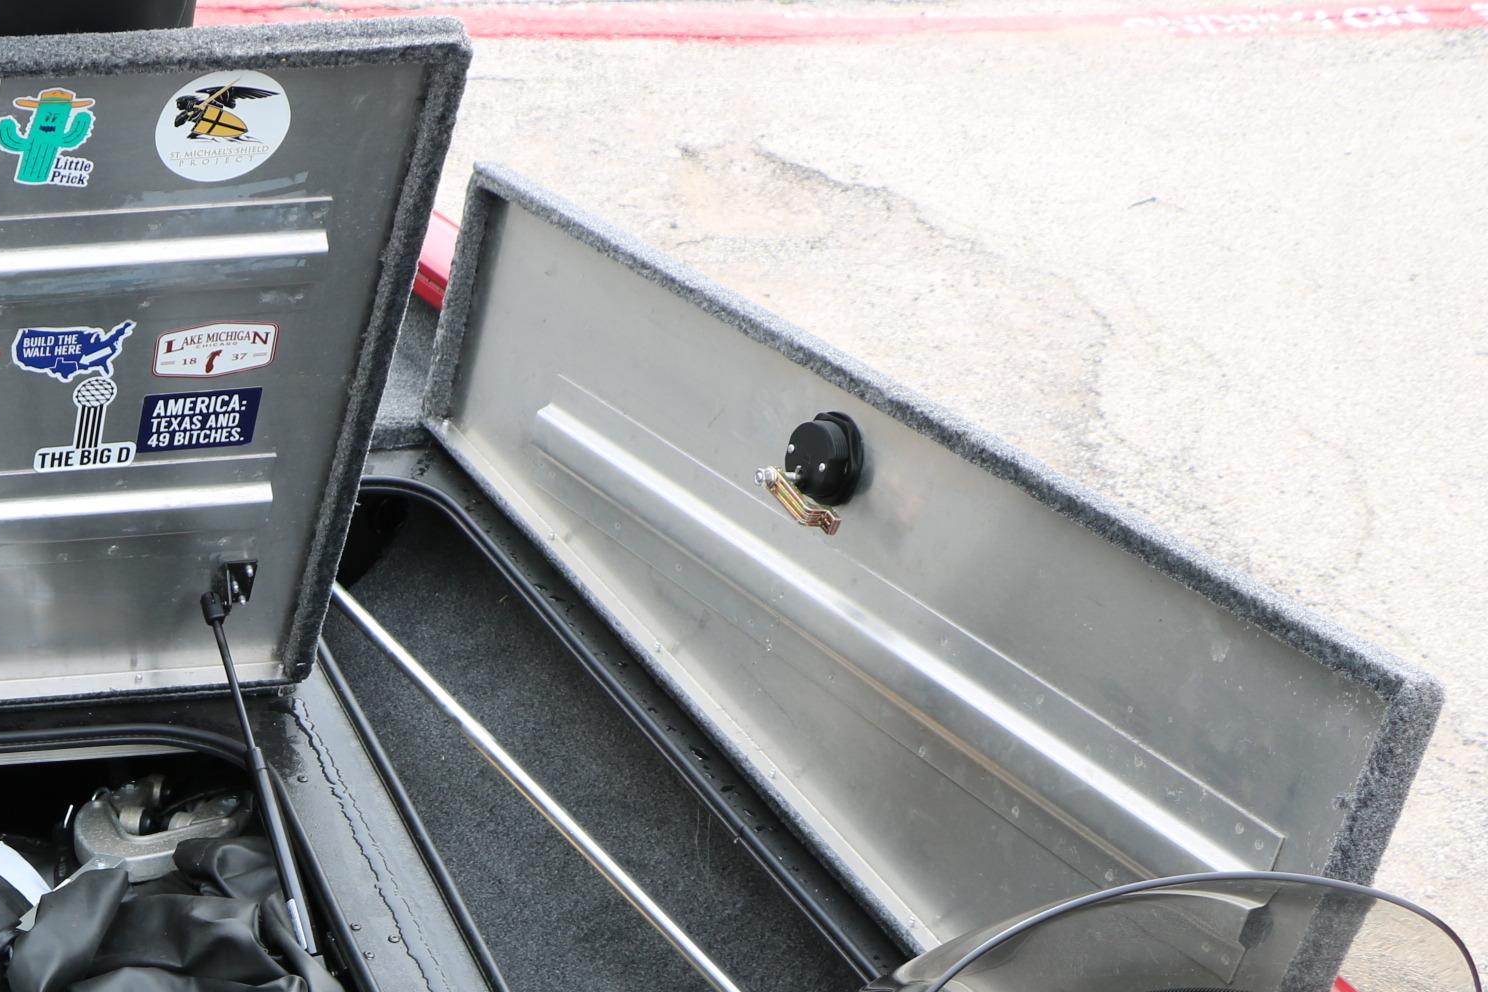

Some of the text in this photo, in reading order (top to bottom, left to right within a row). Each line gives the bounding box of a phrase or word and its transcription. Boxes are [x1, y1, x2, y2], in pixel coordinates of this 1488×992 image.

[184, 147, 233, 159] MICHAEL'S
[235, 145, 270, 154] SHIELD
[54, 157, 92, 172] Little
[178, 155, 254, 168] PROJECT
[50, 170, 87, 185] Prick
[23, 334, 79, 348] BUILD THE
[162, 330, 271, 354] LAKE MICHIGAN
[195, 341, 239, 349] CHICAGO
[23, 344, 82, 358] WALL HERE
[182, 352, 248, 366] 18 37
[152, 394, 248, 417] AMERICA:
[151, 412, 240, 433] TEXAS AND
[147, 427, 245, 448] 49 BITCHES.
[38, 446, 131, 468] THE BIG D
